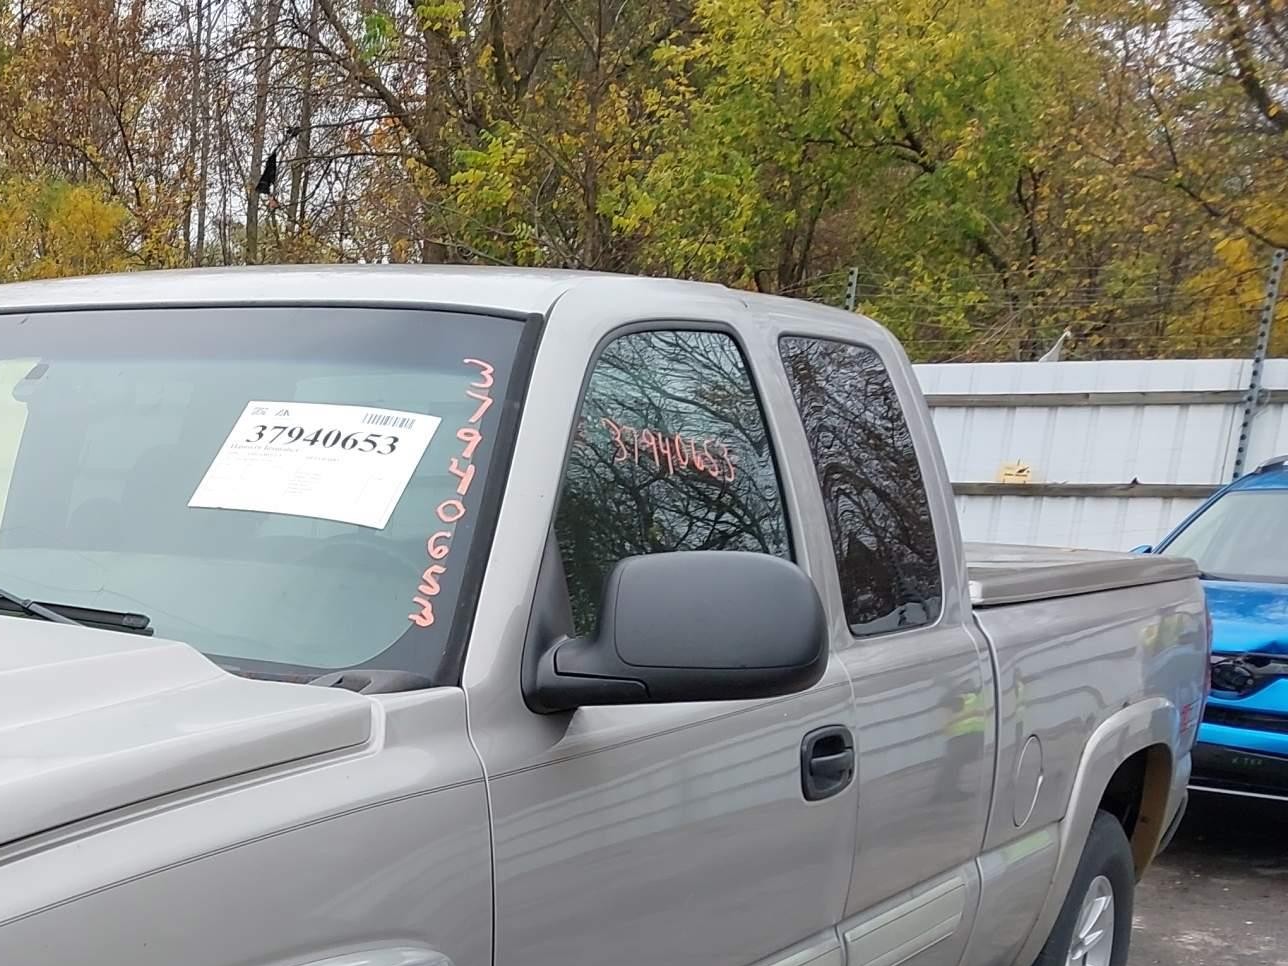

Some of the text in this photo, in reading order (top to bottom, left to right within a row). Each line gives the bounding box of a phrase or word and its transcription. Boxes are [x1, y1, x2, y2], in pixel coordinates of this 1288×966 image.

[245, 424, 400, 456] 37940653
[601, 417, 735, 482] 37940653
[408, 358, 494, 627] 37940653
